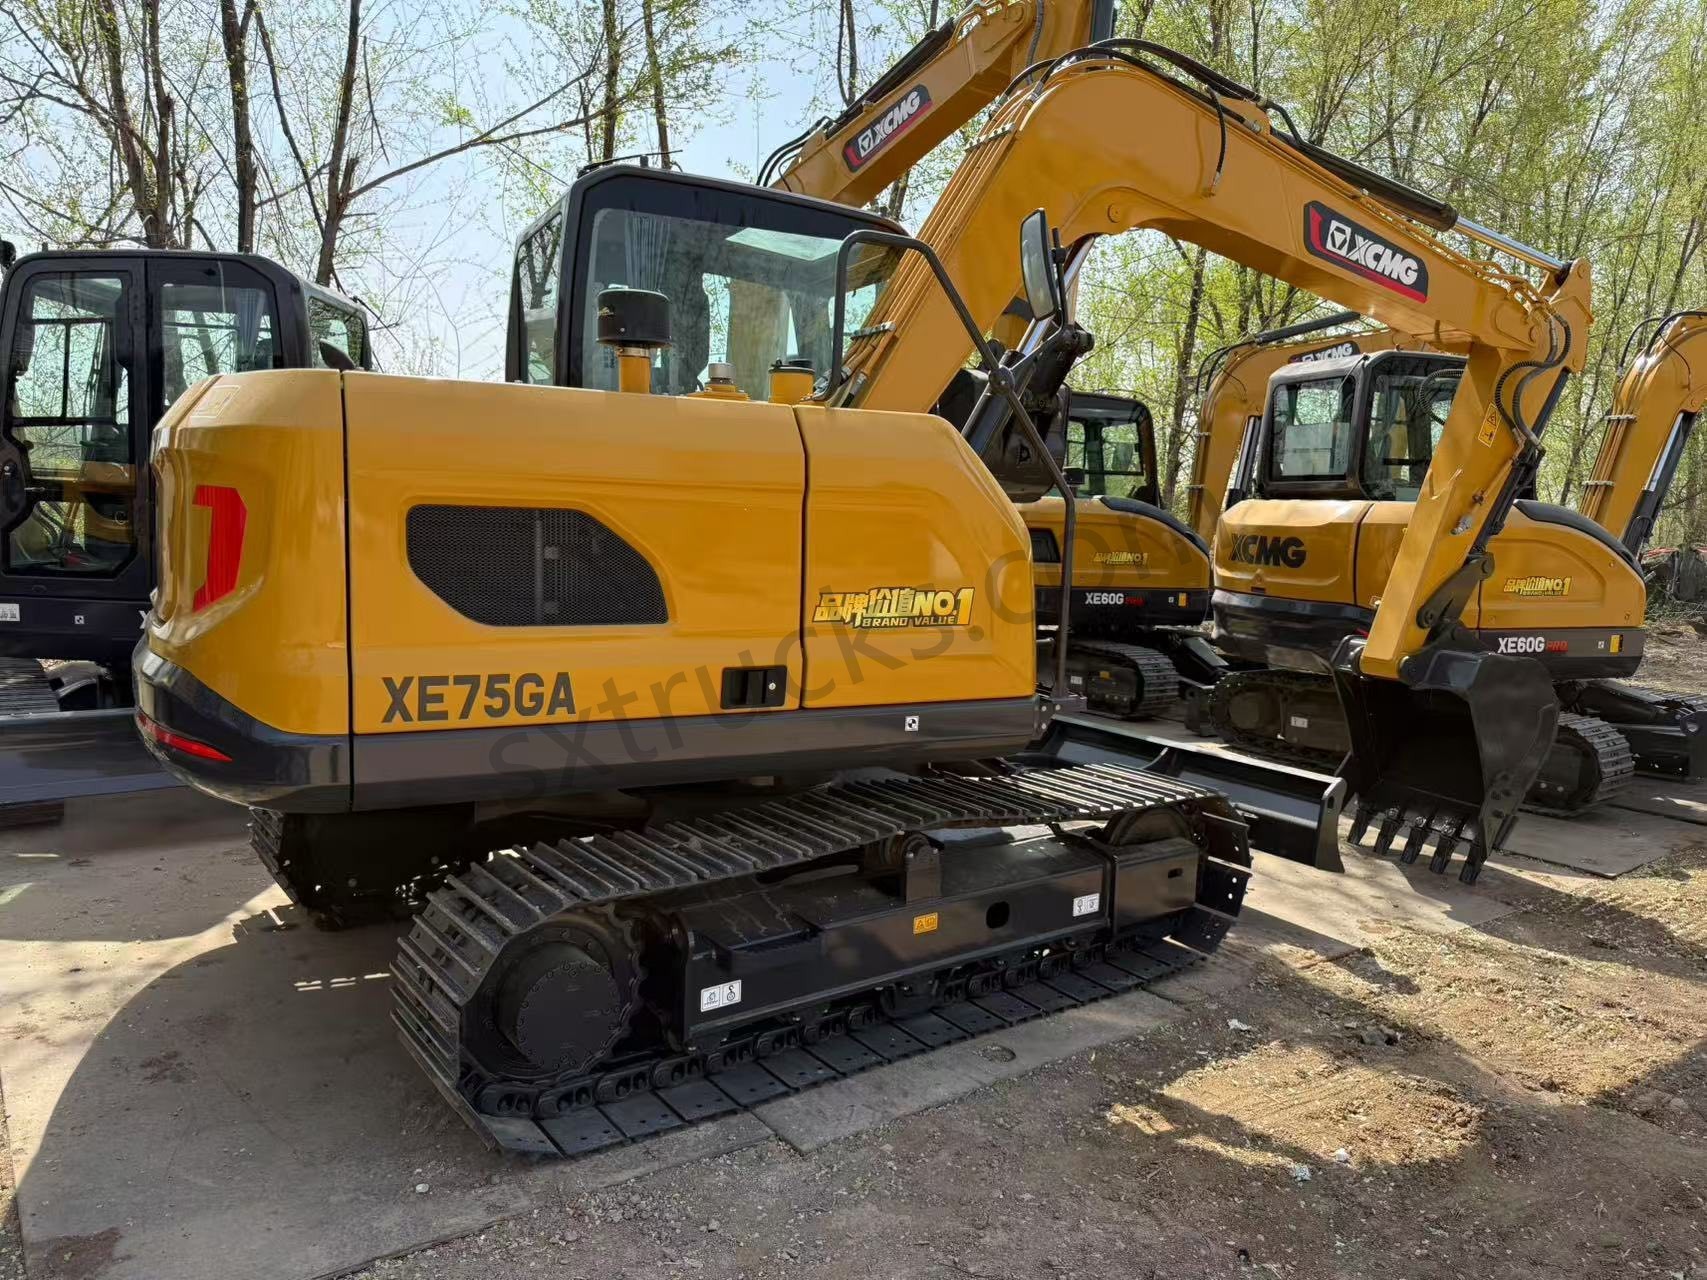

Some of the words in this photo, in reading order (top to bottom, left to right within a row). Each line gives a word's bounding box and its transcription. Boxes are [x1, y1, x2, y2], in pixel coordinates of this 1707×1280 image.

[873, 91, 920, 144] XCMG
[1346, 233, 1418, 285] XCMG
[1228, 533, 1307, 569] XCMG
[1085, 592, 1124, 605] XE60G
[862, 617, 909, 627] BRAND
[914, 617, 956, 625] VALUE
[1498, 637, 1545, 653] XE60G
[381, 671, 576, 723] XE75GA
